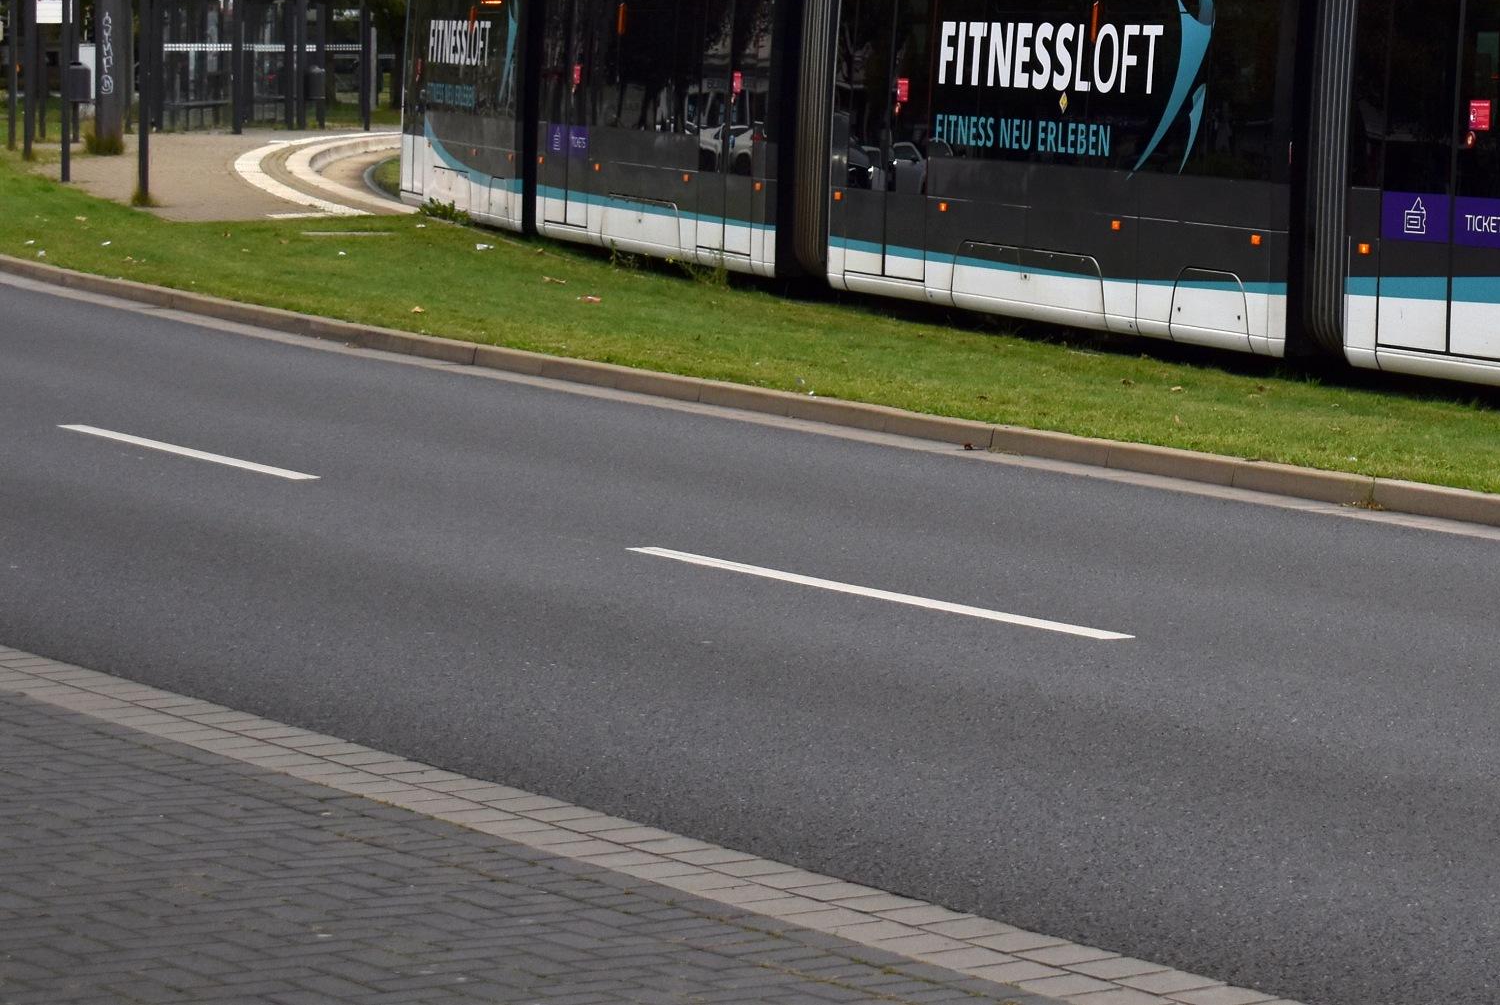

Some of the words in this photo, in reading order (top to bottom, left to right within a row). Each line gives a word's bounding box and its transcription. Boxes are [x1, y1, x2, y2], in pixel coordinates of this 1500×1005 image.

[427, 19, 492, 67] FITNESSLOFT
[937, 20, 1165, 95] FITNESSLOFT
[934, 113, 995, 148] FITNESS
[999, 118, 1032, 152] NEU
[1037, 120, 1112, 158] ERLEBEN
